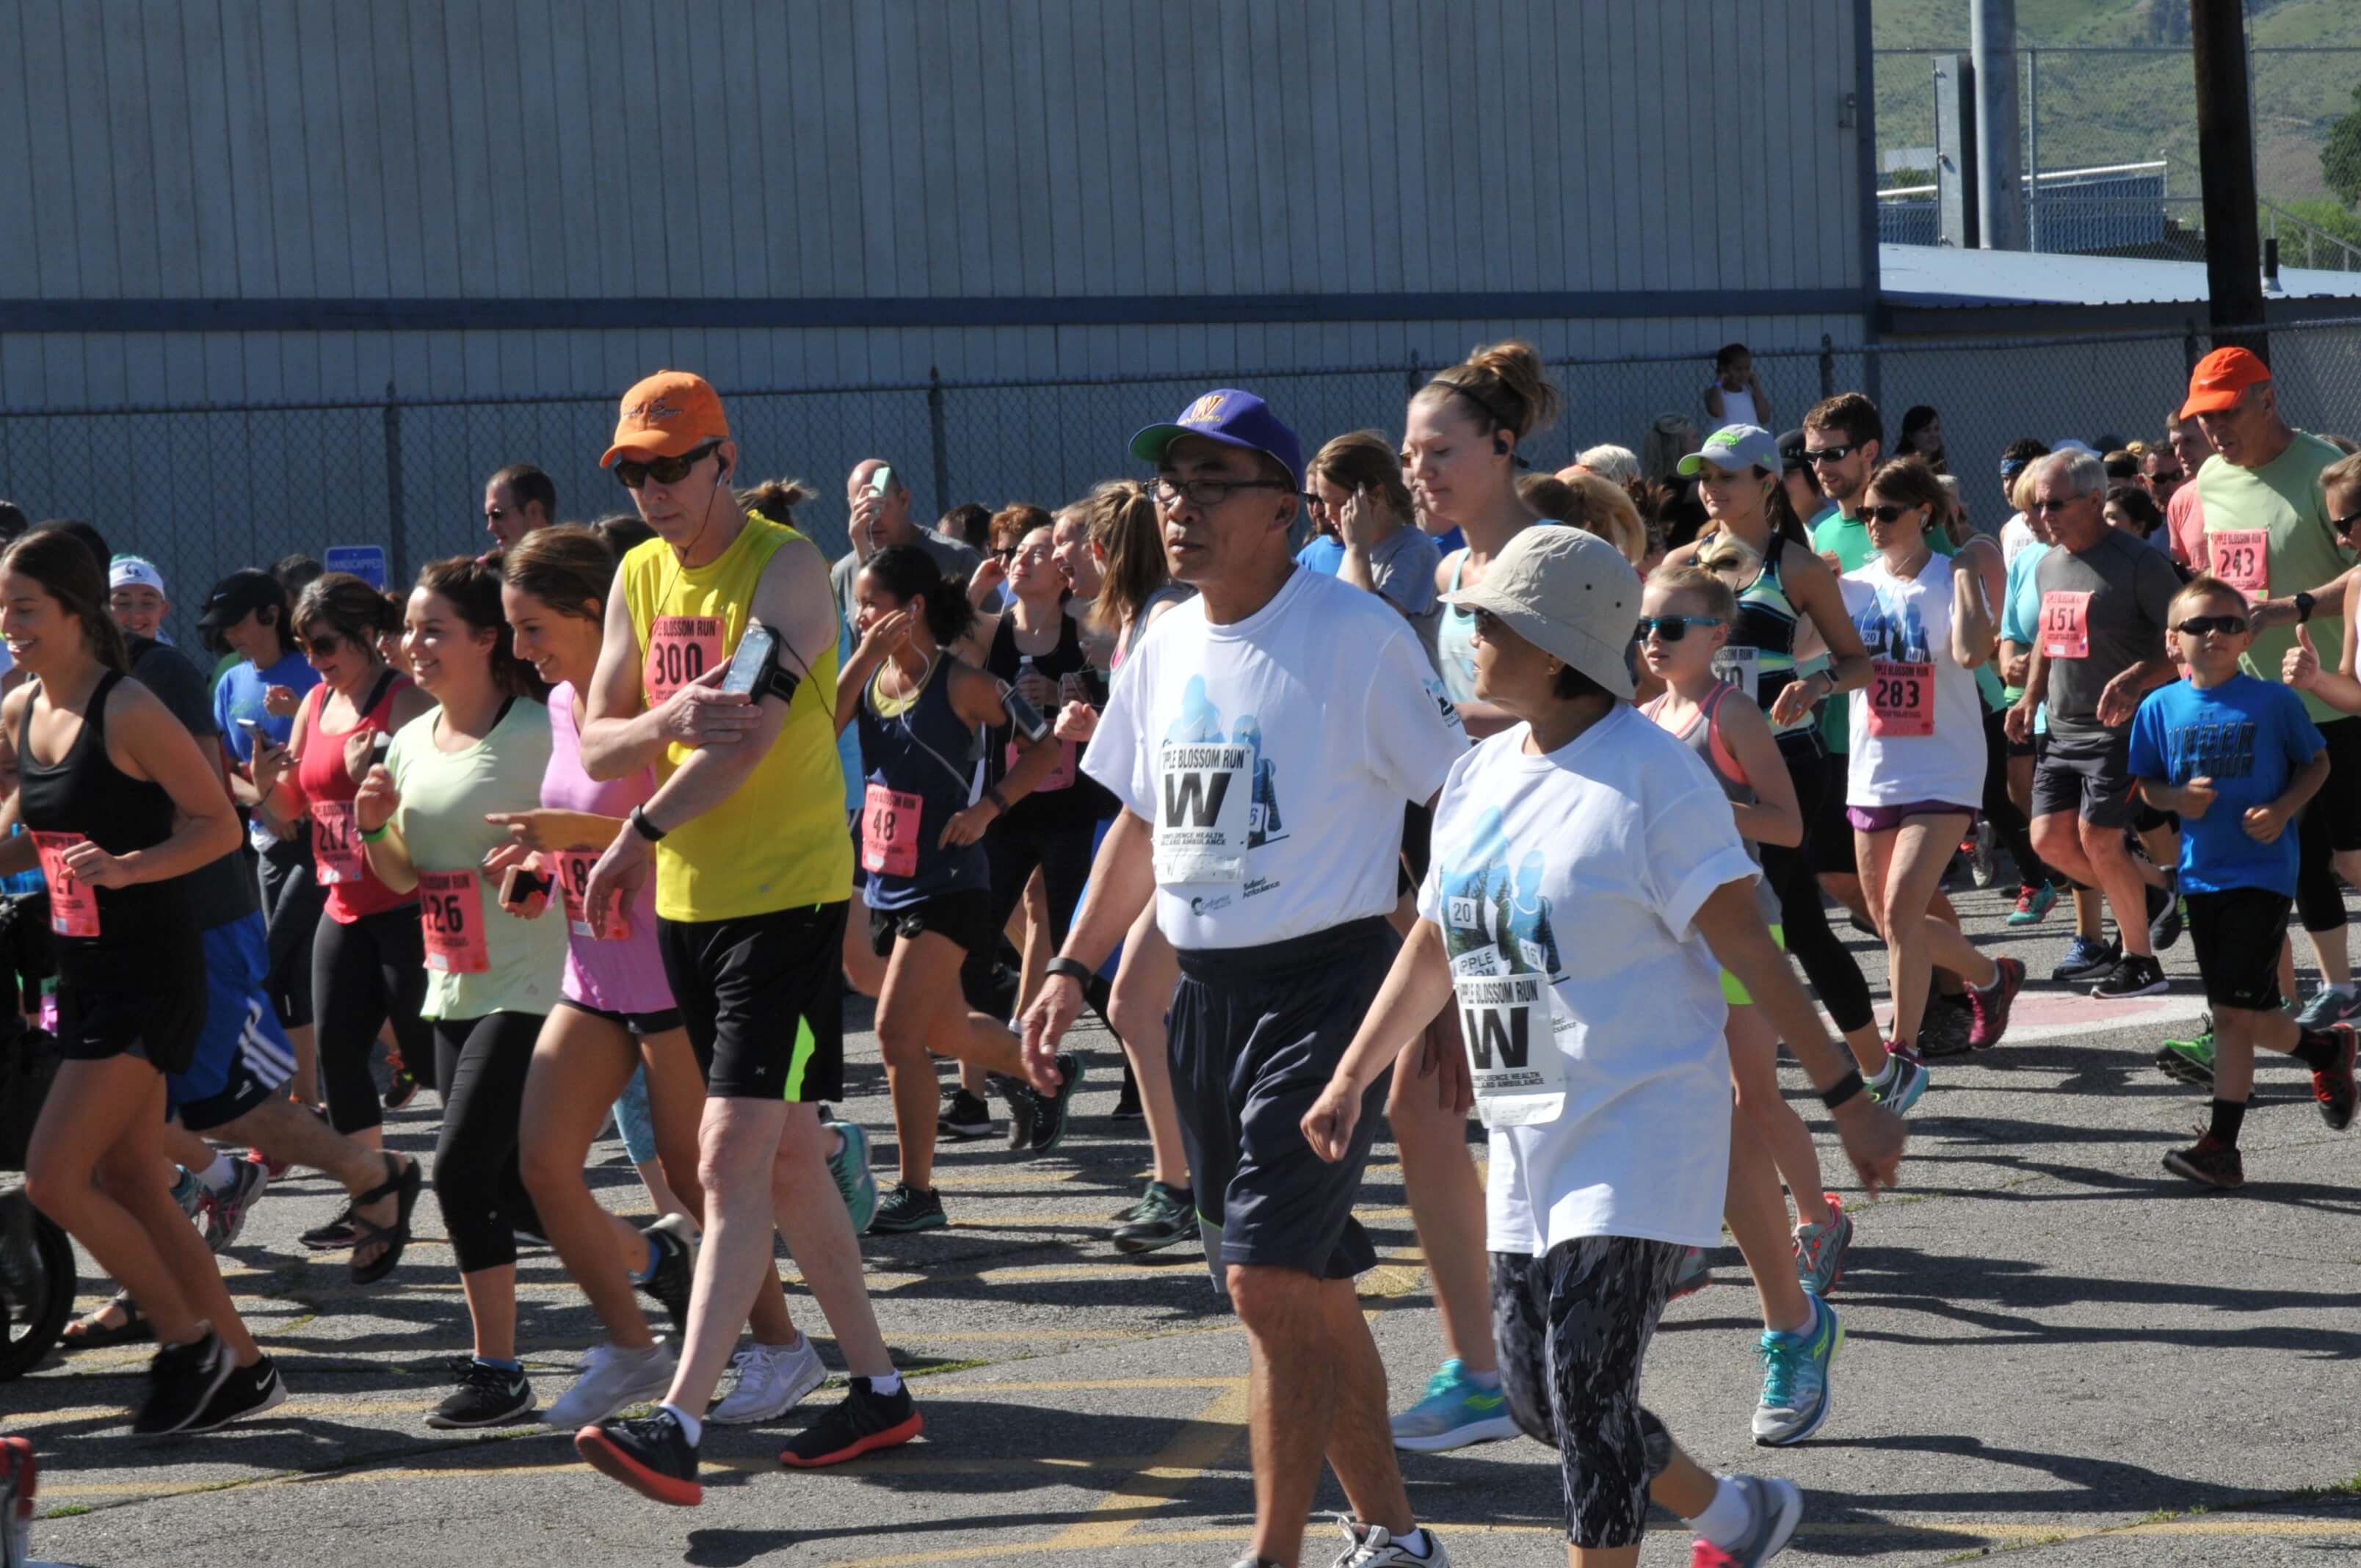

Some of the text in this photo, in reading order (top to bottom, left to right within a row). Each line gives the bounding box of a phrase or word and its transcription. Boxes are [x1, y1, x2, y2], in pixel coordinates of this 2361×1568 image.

[1191, 395, 1225, 418] W
[2228, 534, 2250, 544] BLOSSOM
[2252, 533, 2262, 543] RUN
[2220, 548, 2255, 577] 243
[664, 620, 694, 636] BLOSSOM
[697, 620, 717, 636] RUN
[2048, 608, 2076, 631] 151
[1865, 632, 1876, 642] 20
[655, 642, 702, 685] 300
[1738, 649, 1752, 661] RUN
[1888, 666, 1915, 677] BLOSSOM
[1916, 667, 1929, 677] RUN
[1876, 678, 1919, 708] 283
[1178, 749, 1220, 769] BLOSSOM
[1222, 749, 1244, 769] RUN
[1165, 772, 1233, 828] W
[874, 808, 896, 841] 48
[422, 893, 463, 932] 126
[1454, 902, 1471, 922] 20
[1521, 944, 1538, 965] 16
[1476, 982, 1515, 1004] BLOSSOM
[1516, 980, 1539, 1002] RUN
[1465, 1006, 1528, 1069] W
[1498, 1078, 1545, 1088] AMBULANCE
[1512, 1071, 1540, 1080] HEALTH
